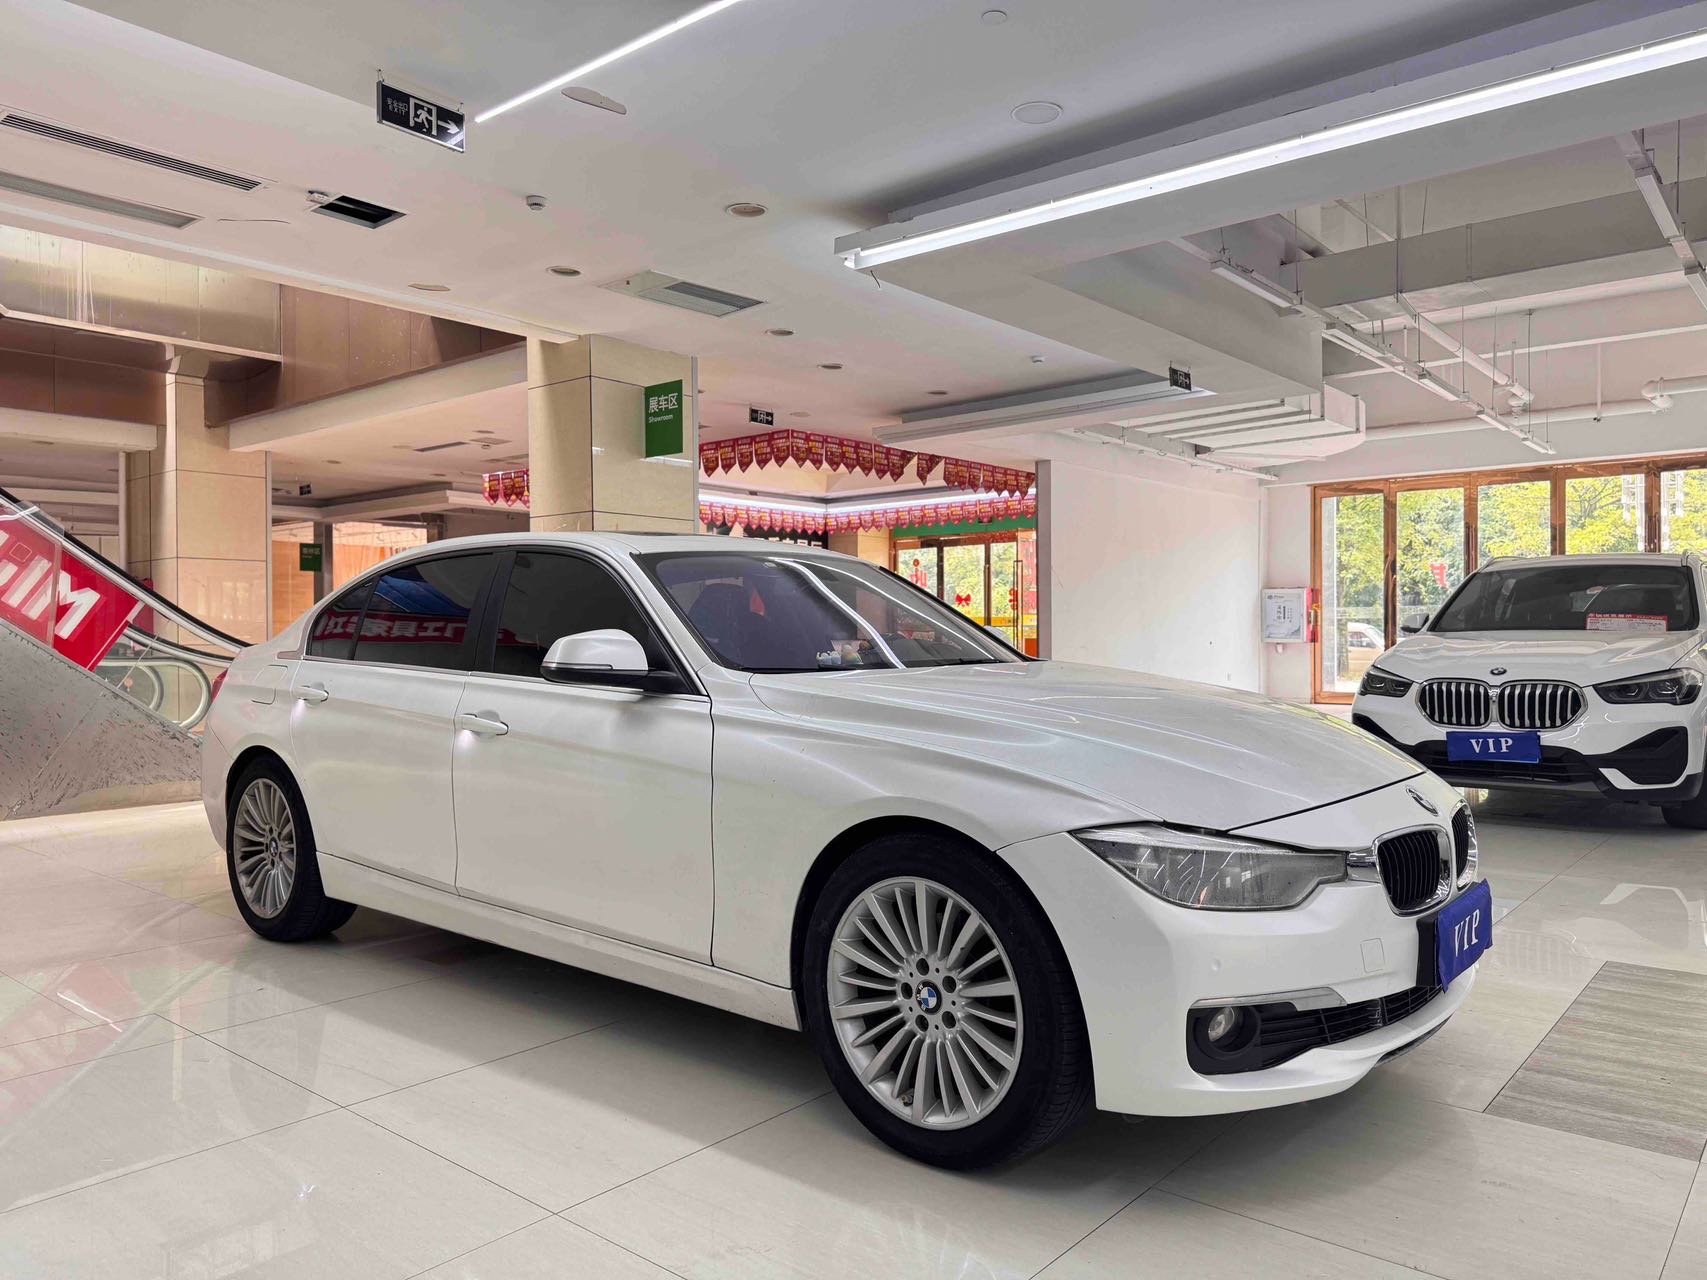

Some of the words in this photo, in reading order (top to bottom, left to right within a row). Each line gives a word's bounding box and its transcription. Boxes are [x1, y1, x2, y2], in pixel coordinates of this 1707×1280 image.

[649, 392, 678, 413] 展车区
[648, 414, 673, 423] Showroom
[1470, 737, 1513, 753] VIP
[1454, 908, 1480, 957] VIP
